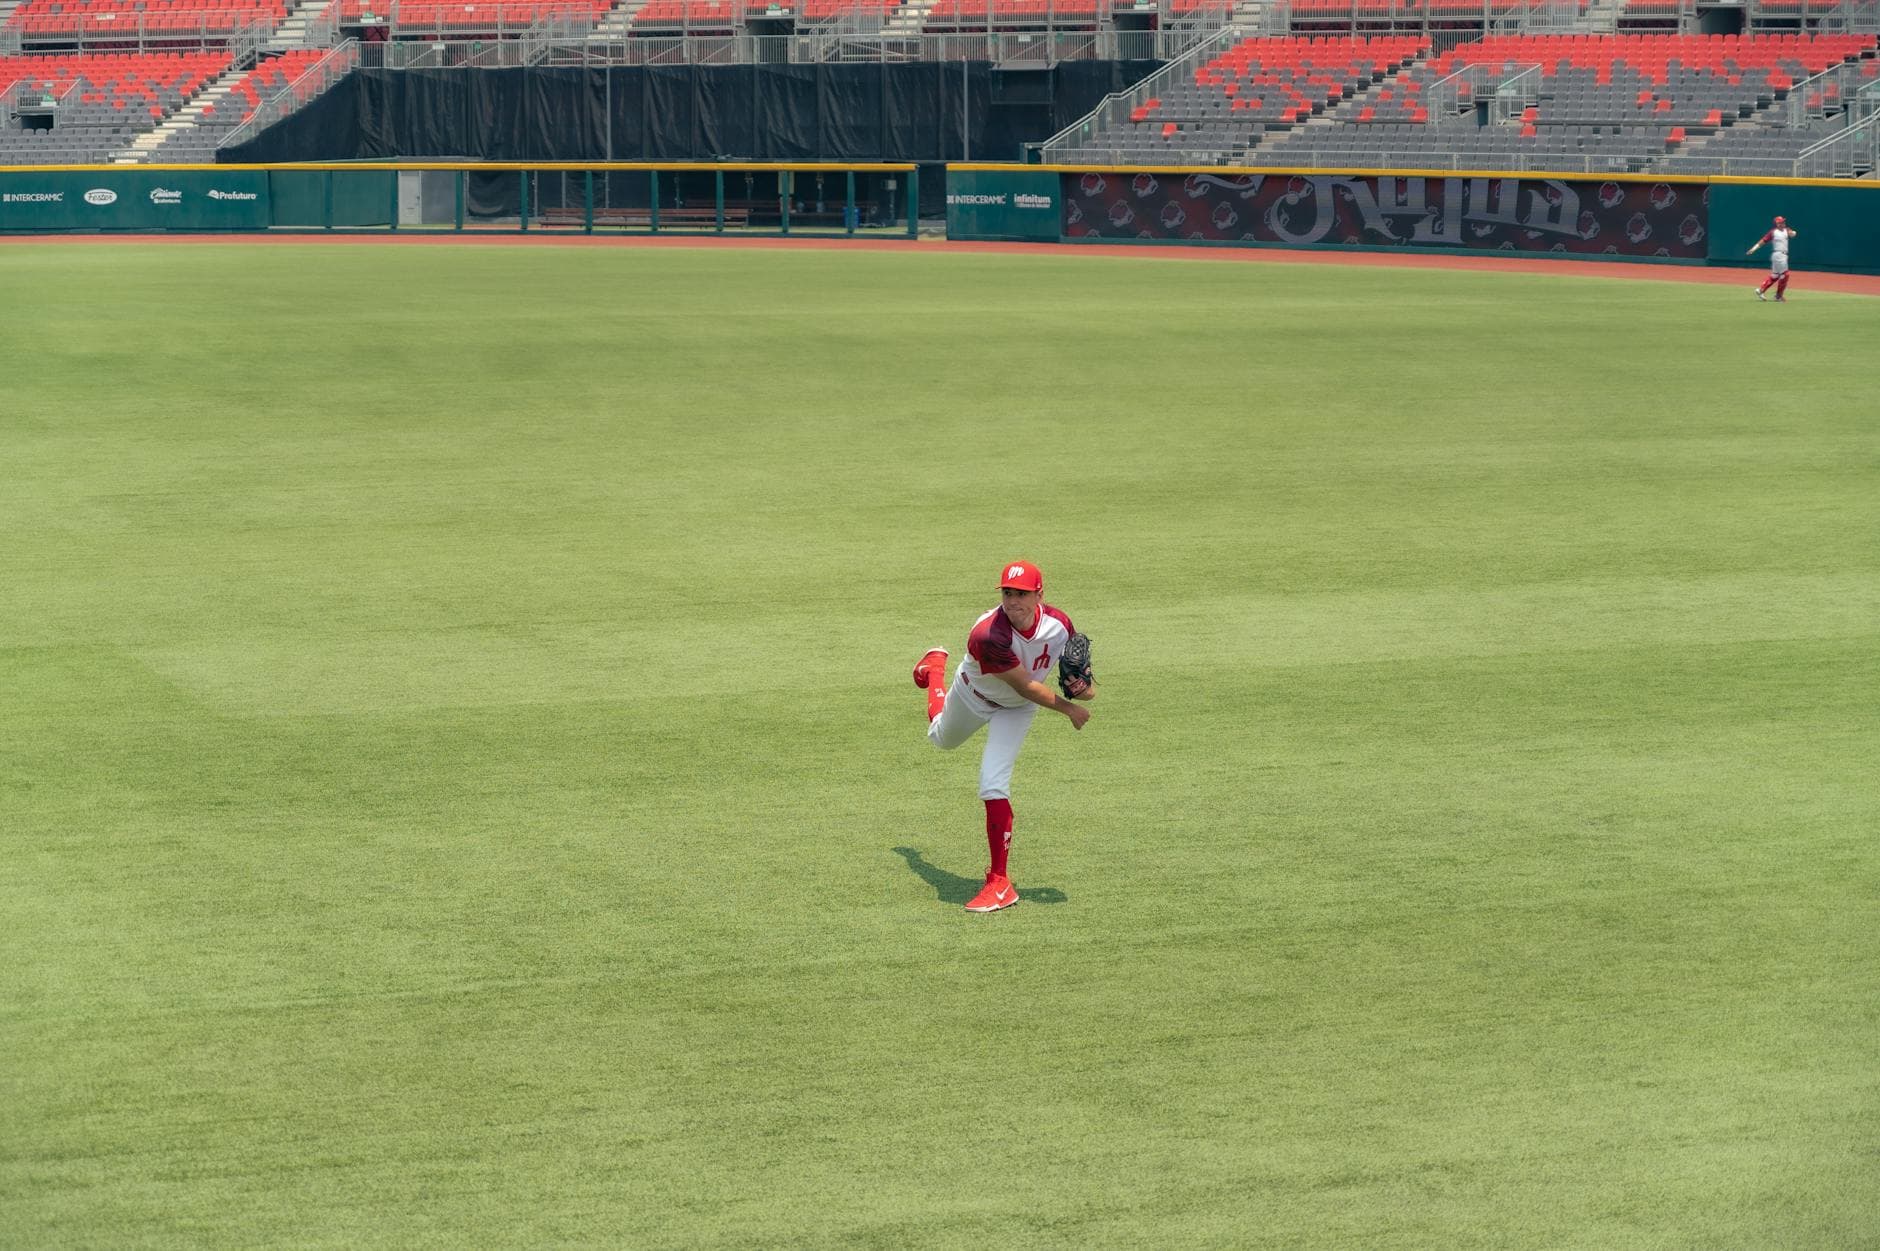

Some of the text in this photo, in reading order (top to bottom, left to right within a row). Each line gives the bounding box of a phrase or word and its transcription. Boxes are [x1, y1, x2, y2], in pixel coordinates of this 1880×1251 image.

[11, 193, 63, 202] INTERCERAMIC
[220, 191, 257, 200] Profuturo
[955, 194, 1006, 204] INTERCERAMIC
